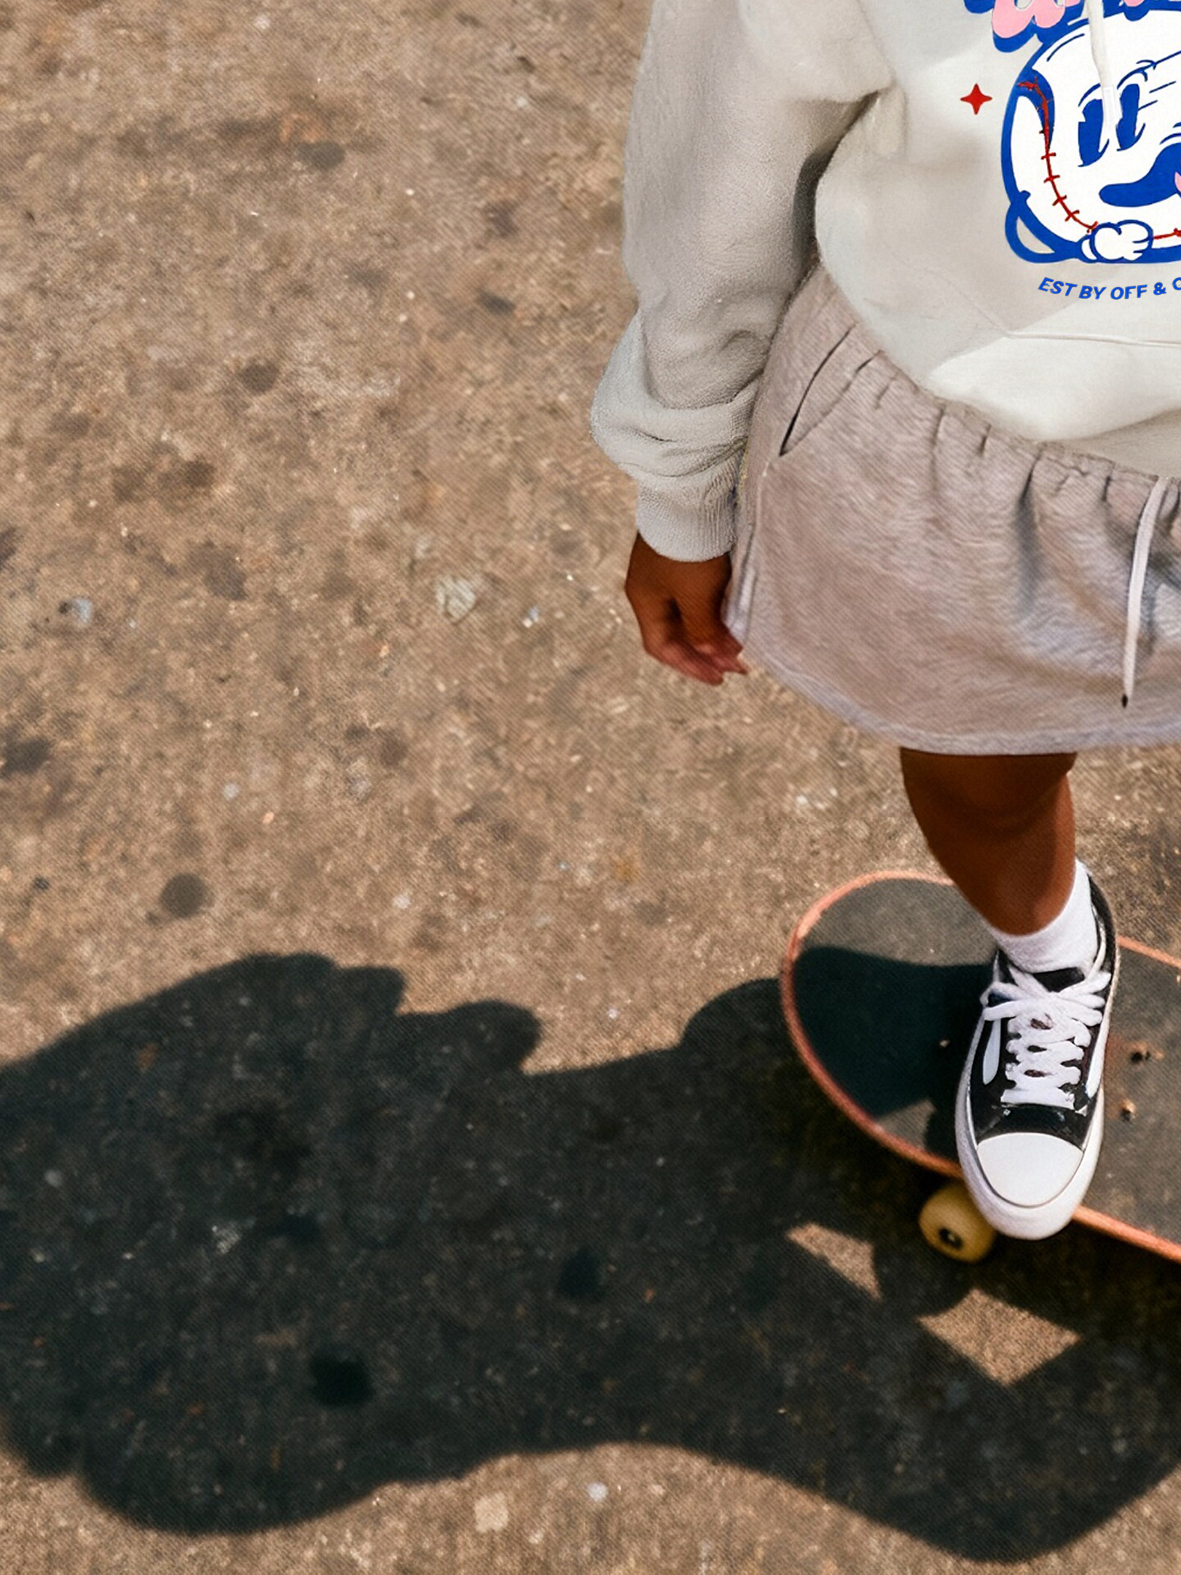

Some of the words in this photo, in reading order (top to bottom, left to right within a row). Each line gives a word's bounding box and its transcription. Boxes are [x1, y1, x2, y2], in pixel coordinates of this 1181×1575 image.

[1038, 277, 1077, 297] EST
[1078, 284, 1107, 300] BY
[1110, 284, 1148, 300] OFF
[1153, 281, 1167, 296] &
